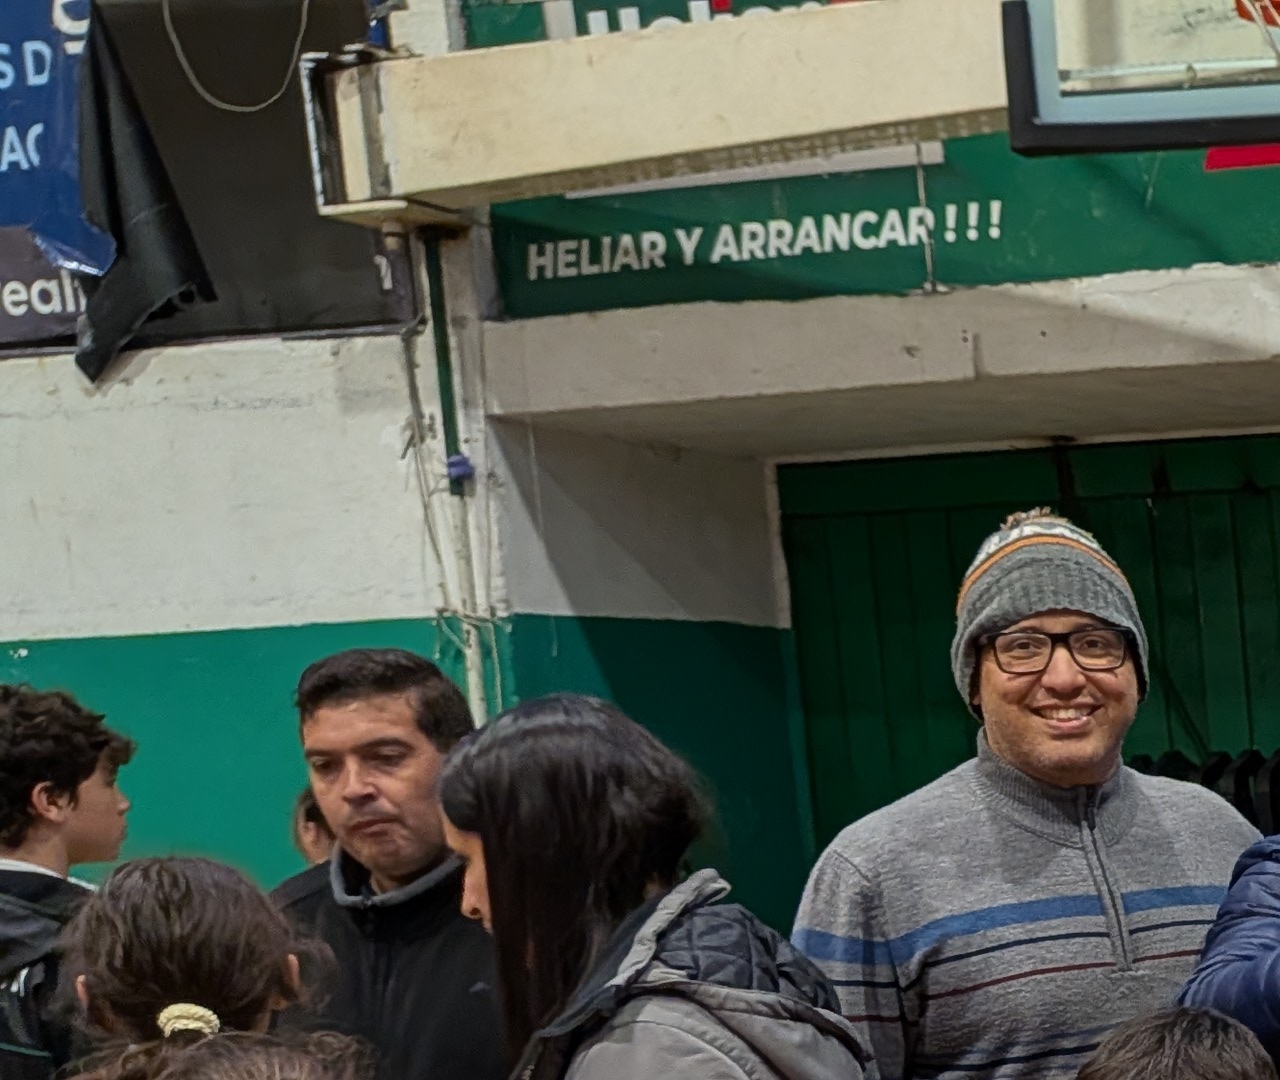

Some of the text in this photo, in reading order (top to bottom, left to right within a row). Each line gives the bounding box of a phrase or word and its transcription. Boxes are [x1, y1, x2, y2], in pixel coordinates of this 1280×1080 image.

[527, 230, 667, 281] HELIAR
[673, 226, 703, 266] Y
[710, 206, 935, 264] ARRANCAR
